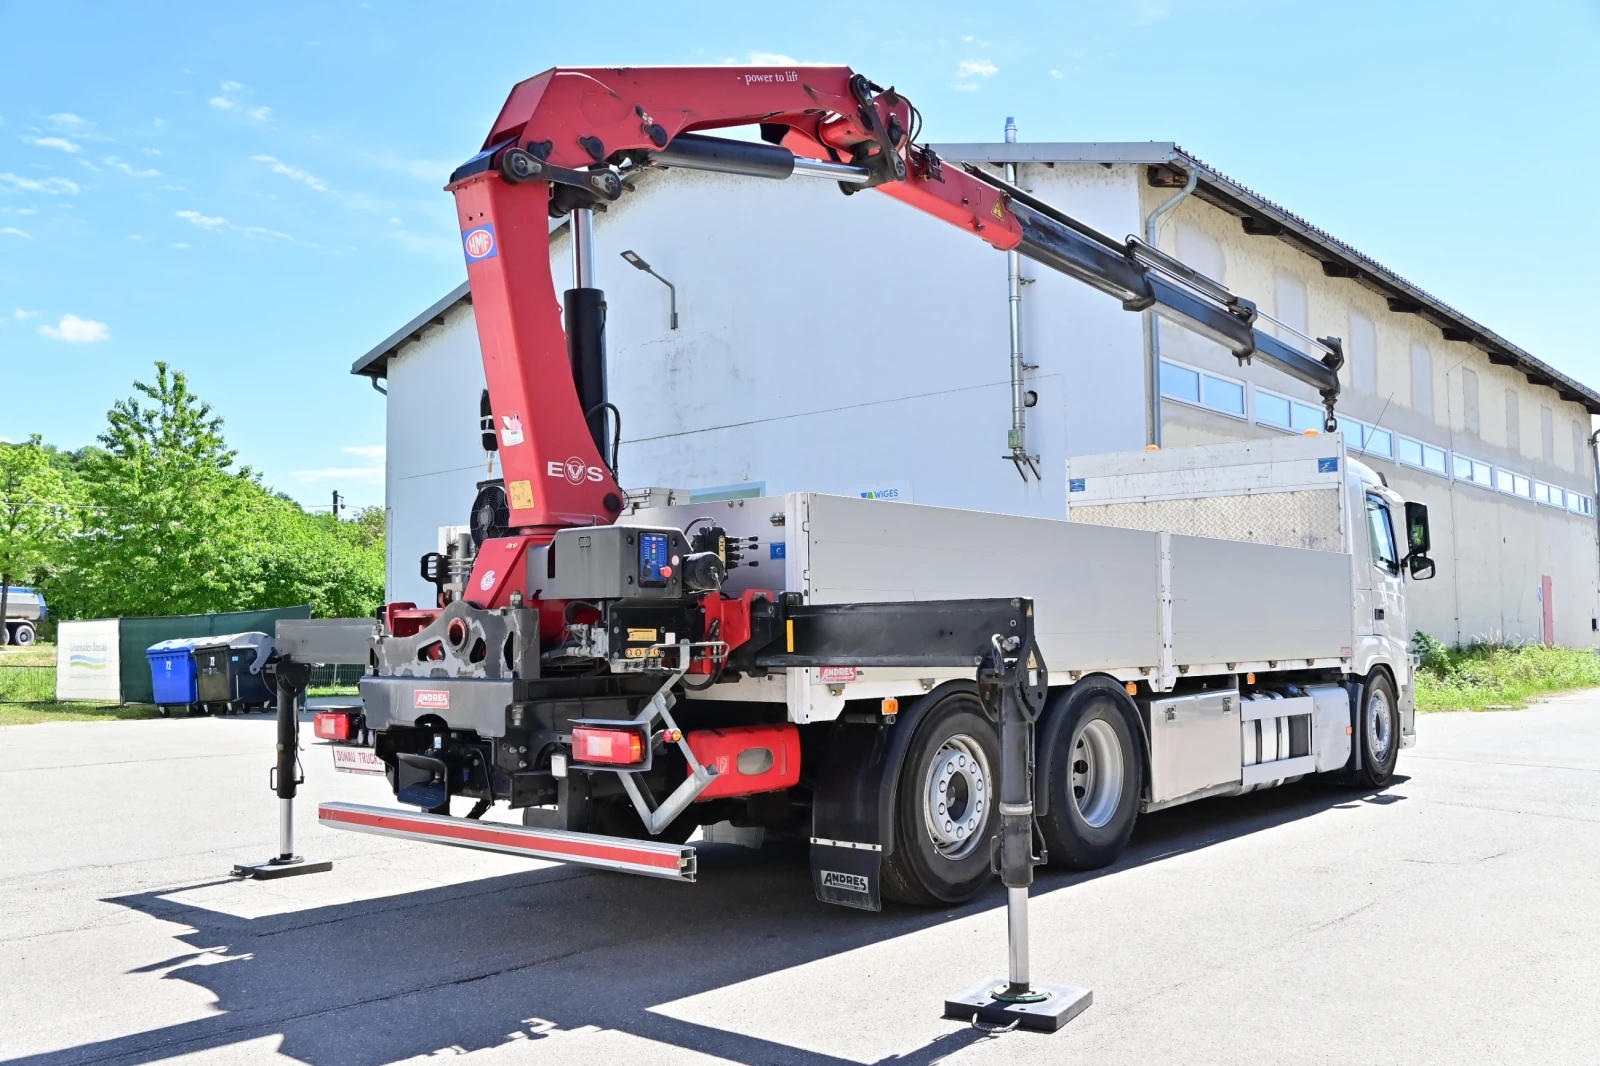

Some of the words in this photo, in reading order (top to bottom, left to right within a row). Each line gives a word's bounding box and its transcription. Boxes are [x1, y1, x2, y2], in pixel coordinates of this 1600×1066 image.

[745, 74, 773, 85] power
[775, 74, 784, 82] to
[785, 71, 798, 82] lift
[469, 233, 489, 255] HMF
[874, 489, 899, 499] WIGES
[165, 661, 172, 671] 72
[820, 667, 855, 681] ANDRES
[416, 693, 448, 706] ANDRES
[336, 750, 356, 763] DONAU
[823, 872, 867, 892] ANDRES
